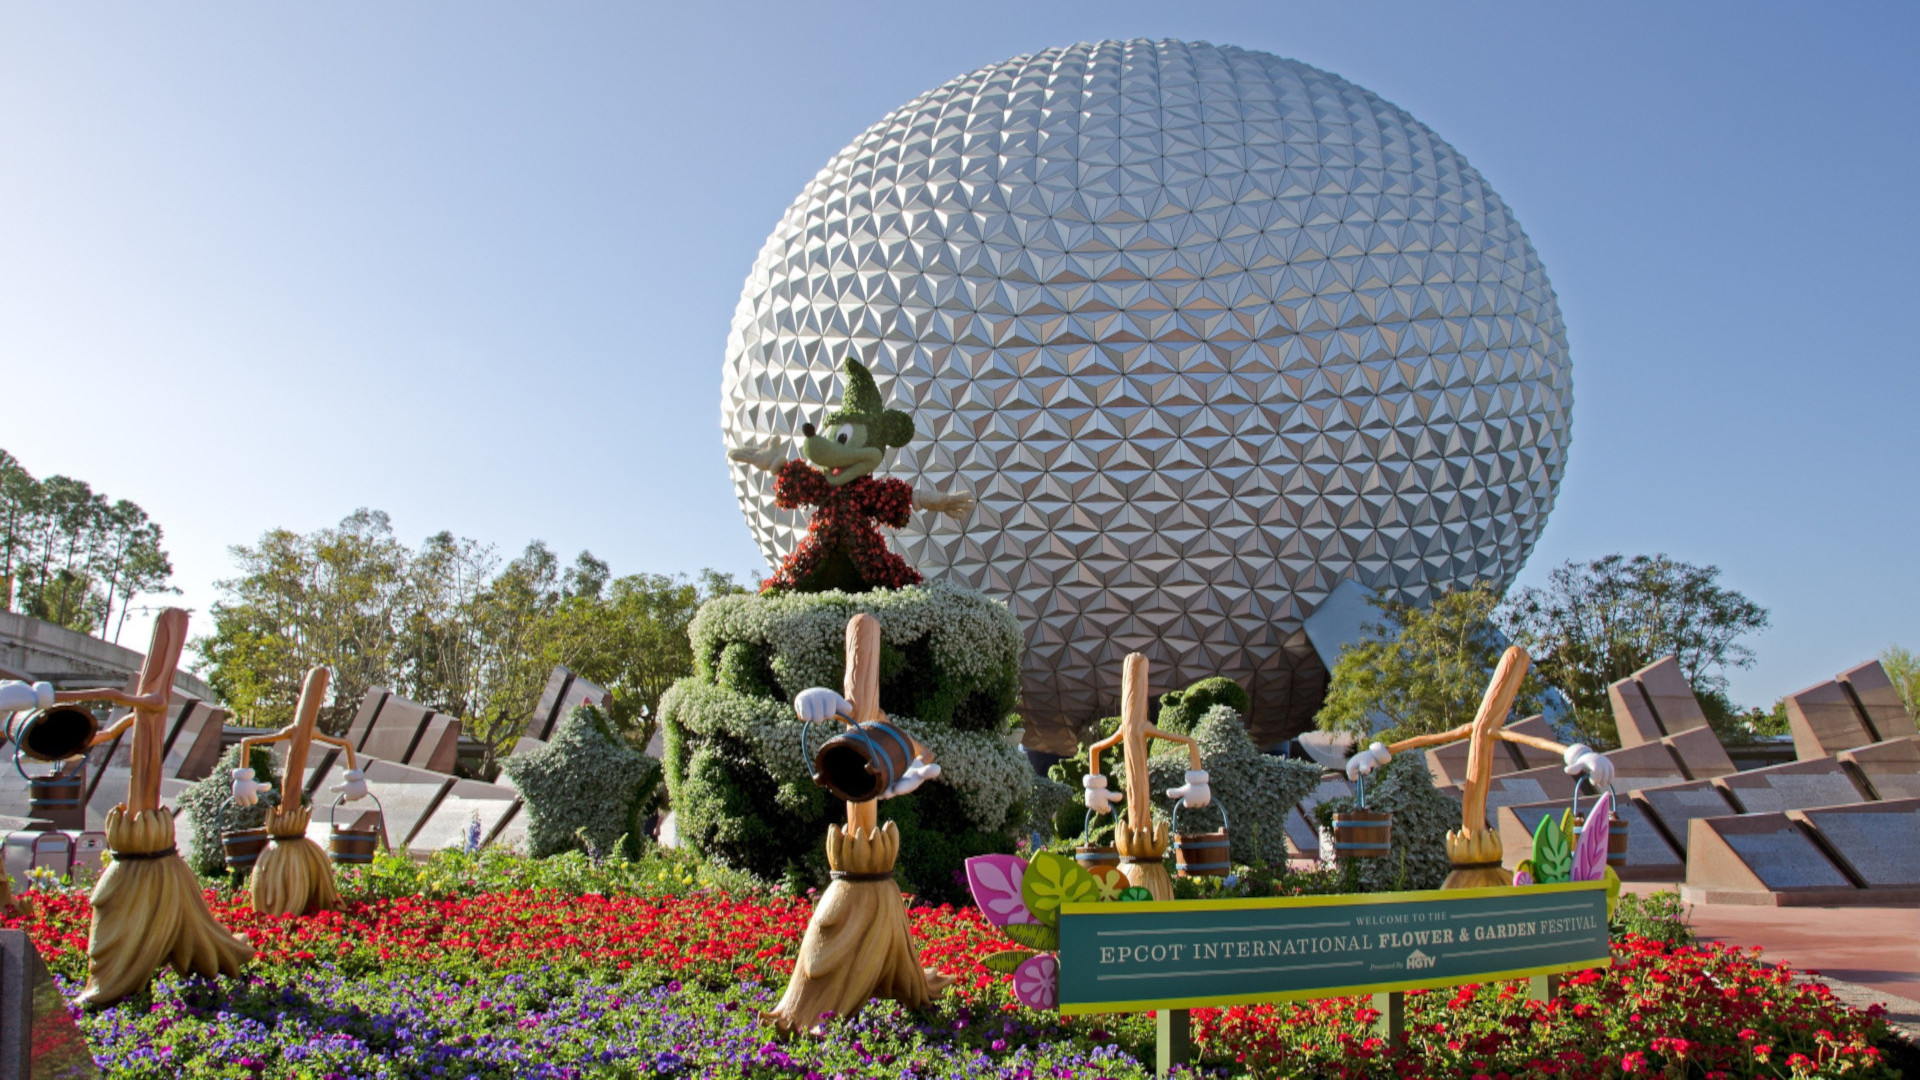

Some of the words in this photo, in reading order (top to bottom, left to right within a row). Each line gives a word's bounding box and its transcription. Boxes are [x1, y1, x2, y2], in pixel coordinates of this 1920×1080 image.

[1356, 914, 1410, 926] WELCOME
[1412, 912, 1426, 922] TO
[1428, 911, 1447, 921] THE
[1099, 944, 1183, 964] EPCOT
[1193, 934, 1373, 960] INTERNATIONAL
[1378, 928, 1454, 949] FLOWER
[1459, 927, 1471, 942] &
[1474, 921, 1537, 941] GARDEN
[1540, 915, 1597, 934] FESTIVAL
[1406, 956, 1436, 970] HGTV
